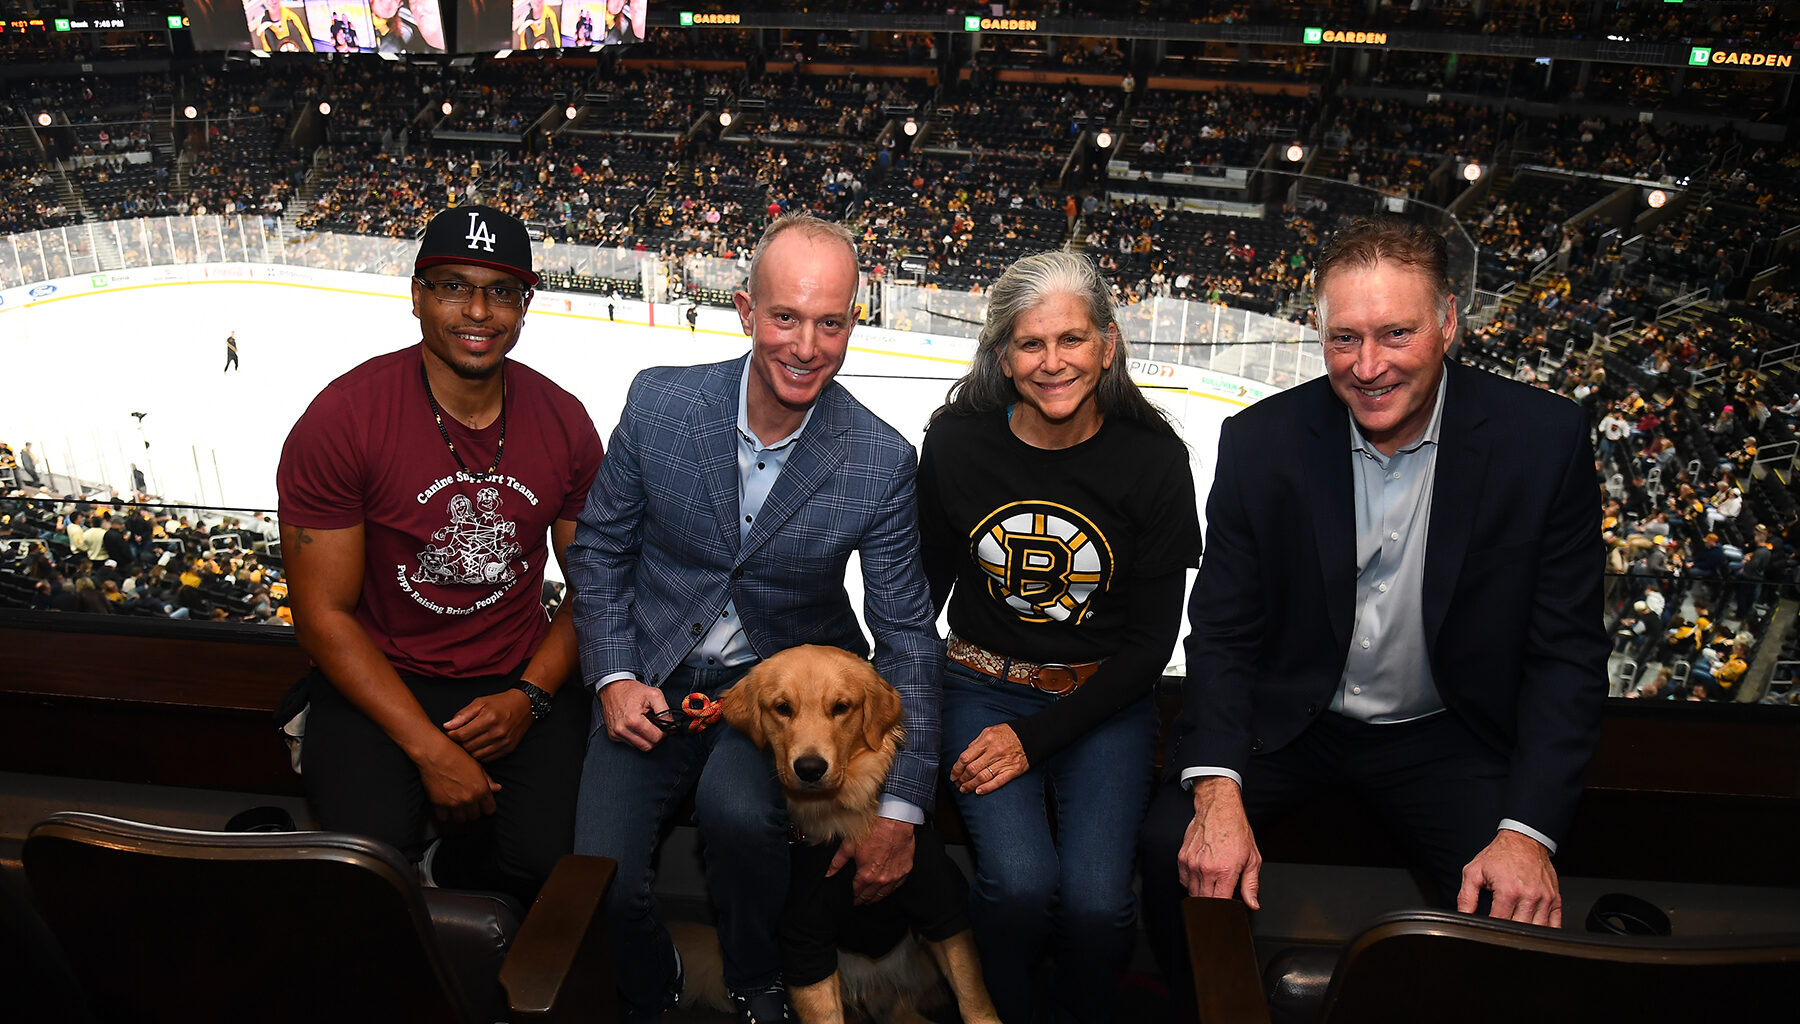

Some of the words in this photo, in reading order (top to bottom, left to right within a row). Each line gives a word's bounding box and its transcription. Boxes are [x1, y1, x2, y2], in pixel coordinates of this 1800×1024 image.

[681, 12, 693, 25] TD
[693, 13, 740, 24] GARDEN
[966, 17, 980, 29] TD
[981, 18, 1037, 31] GARDEN
[1306, 28, 1321, 42] TD
[1322, 30, 1387, 44] GARDEN
[1691, 49, 1710, 64] TD
[1712, 51, 1792, 67] GARDEN
[465, 212, 496, 252] LA
[416, 475, 455, 505] Canine
[455, 471, 505, 485] Suport
[506, 476, 539, 506] Teams
[1004, 533, 1072, 608] B
[397, 564, 413, 593] Puppy
[410, 591, 444, 614] Raising
[445, 605, 475, 616] Brings
[475, 588, 504, 610] People
